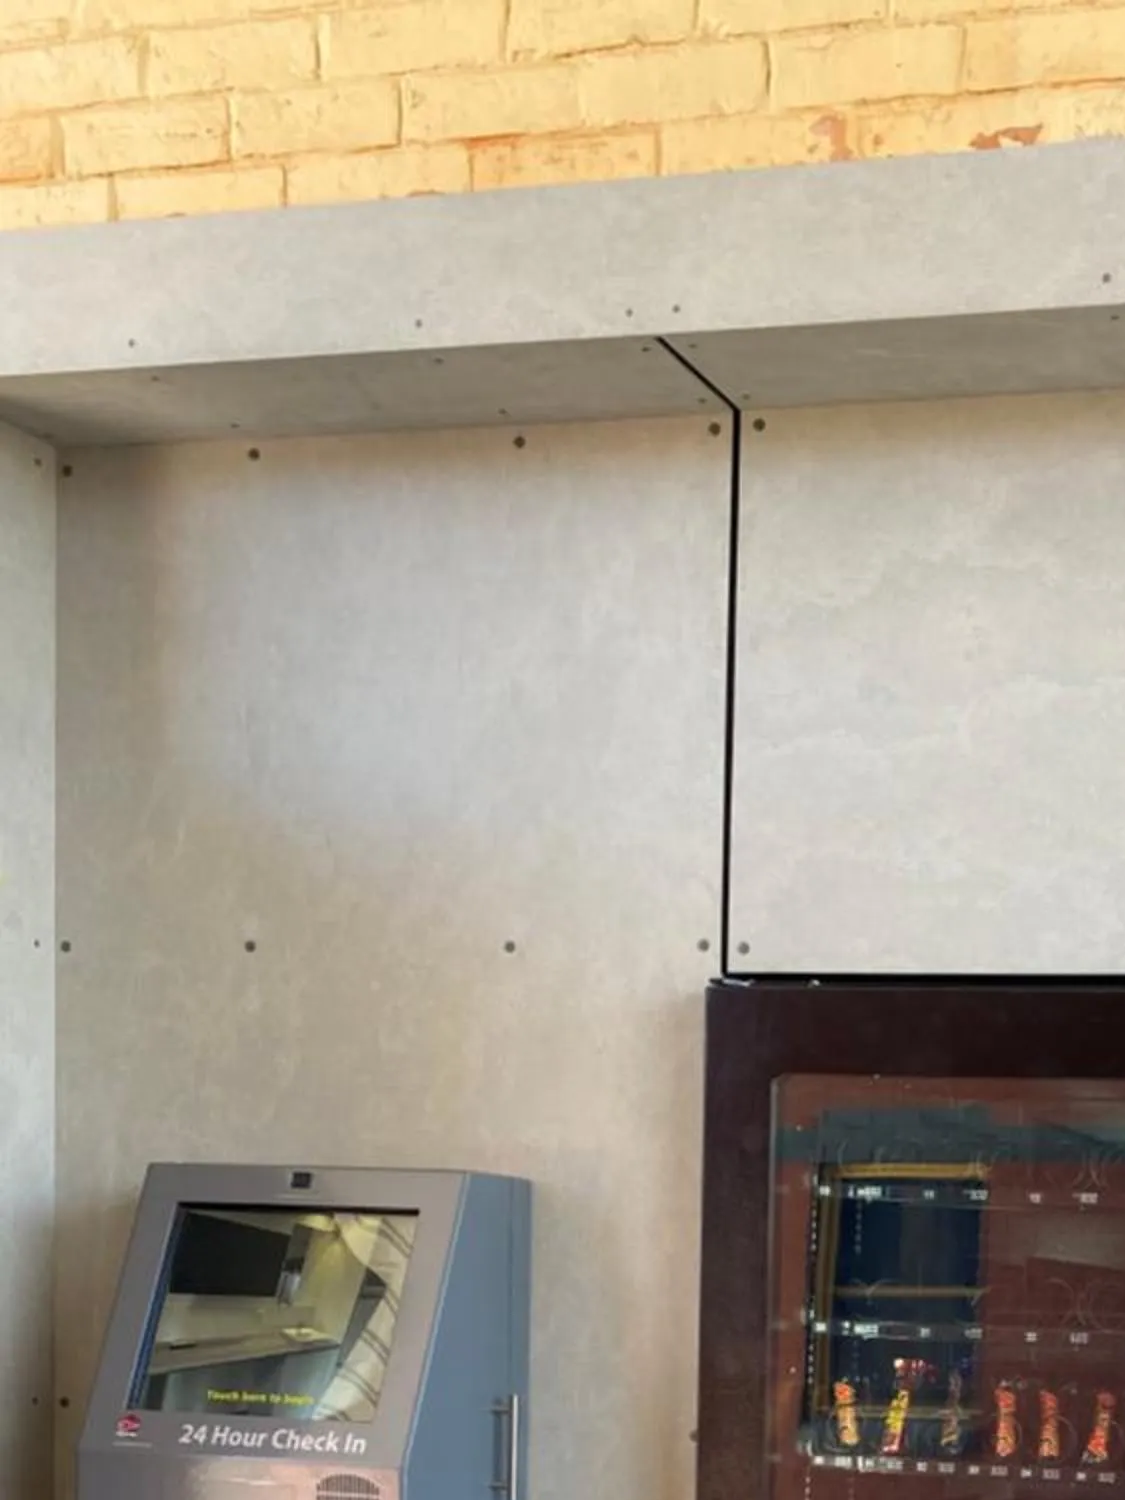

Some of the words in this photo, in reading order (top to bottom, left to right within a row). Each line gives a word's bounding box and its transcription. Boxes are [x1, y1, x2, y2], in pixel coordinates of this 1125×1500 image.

[178, 1423, 208, 1445] 24
[211, 1425, 268, 1448] Hour
[271, 1428, 339, 1452] Check
[343, 1433, 368, 1455] In
